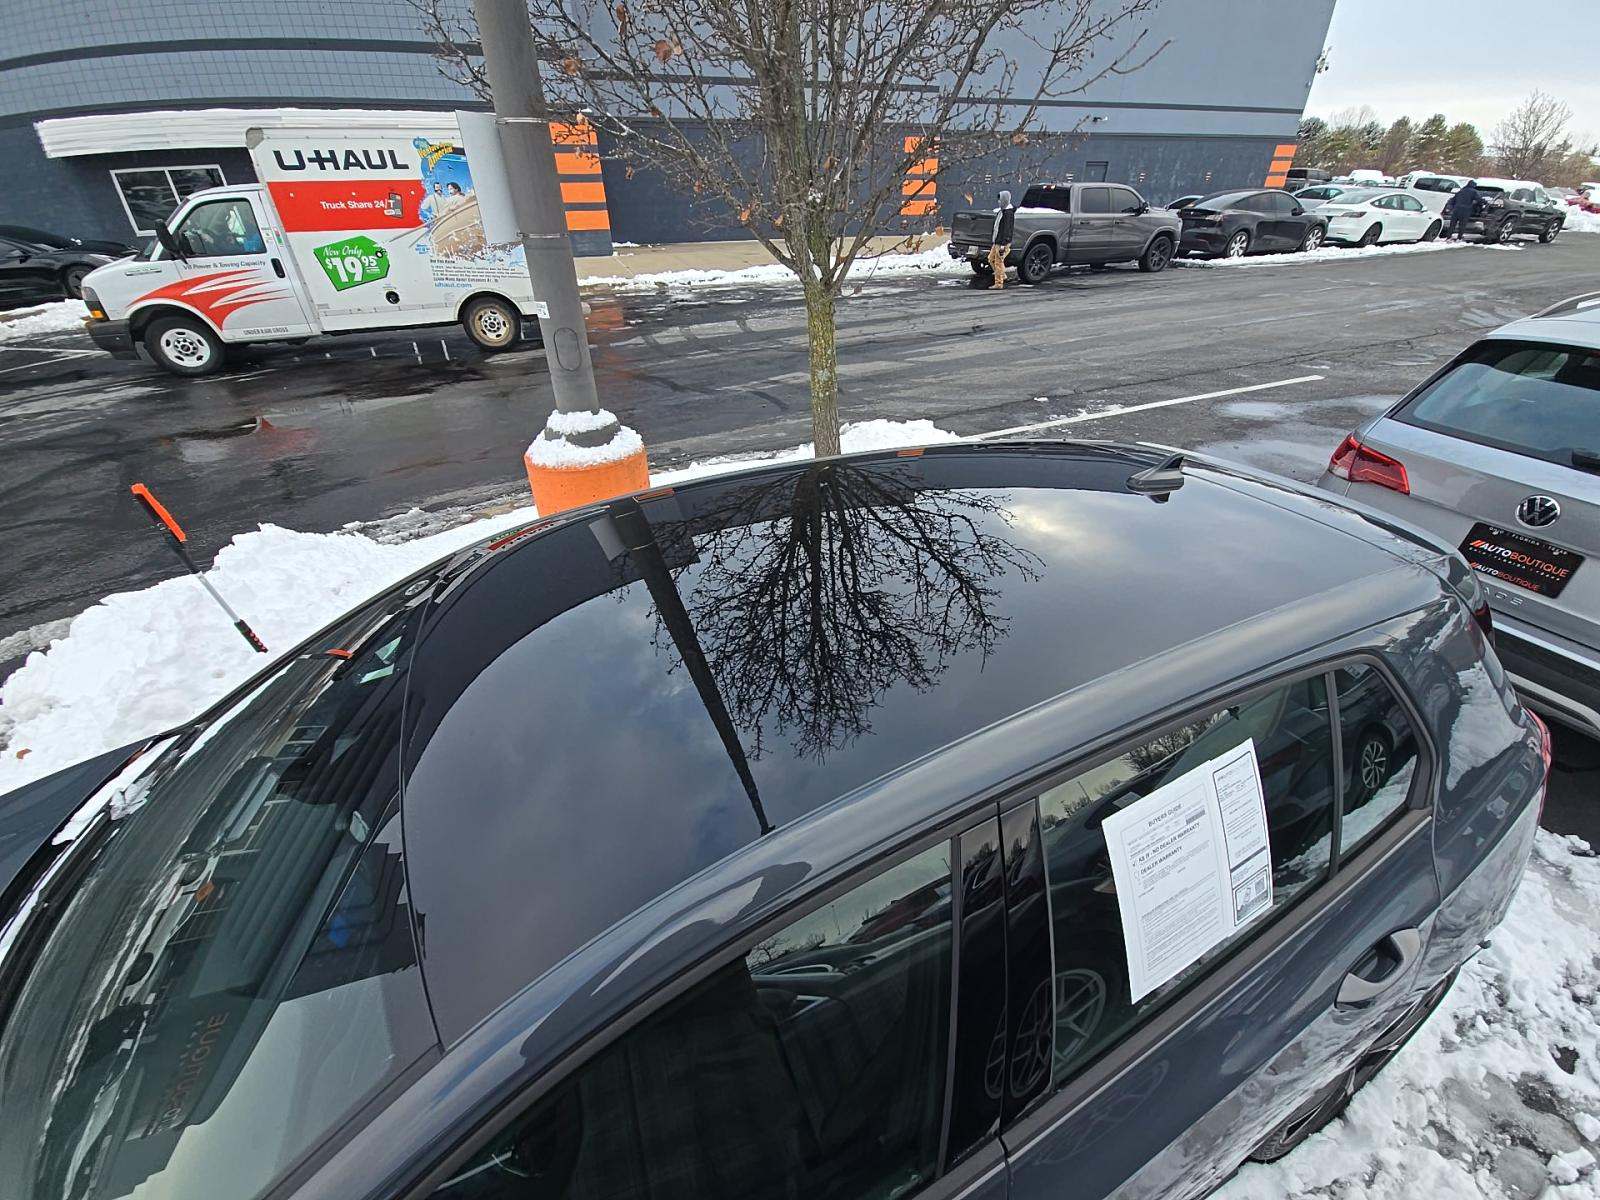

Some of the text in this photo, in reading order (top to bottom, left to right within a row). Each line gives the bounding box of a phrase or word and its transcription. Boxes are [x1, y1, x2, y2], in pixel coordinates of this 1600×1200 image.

[272, 149, 410, 171] U-HAUL
[319, 201, 347, 209] Truck
[347, 200, 373, 209] Share
[323, 245, 363, 258] Now Only
[219, 261, 240, 269] Towing
[240, 260, 266, 268] Capacity
[1479, 541, 1569, 577] AUTOBOUTIQUE
[1148, 803, 1182, 827] BUYERS GUIDE
[1159, 836, 1178, 850] DEALER
[1177, 822, 1201, 840] WARRANTY
[1140, 860, 1159, 875] DEALER
[1158, 845, 1183, 864] WARRANTY
